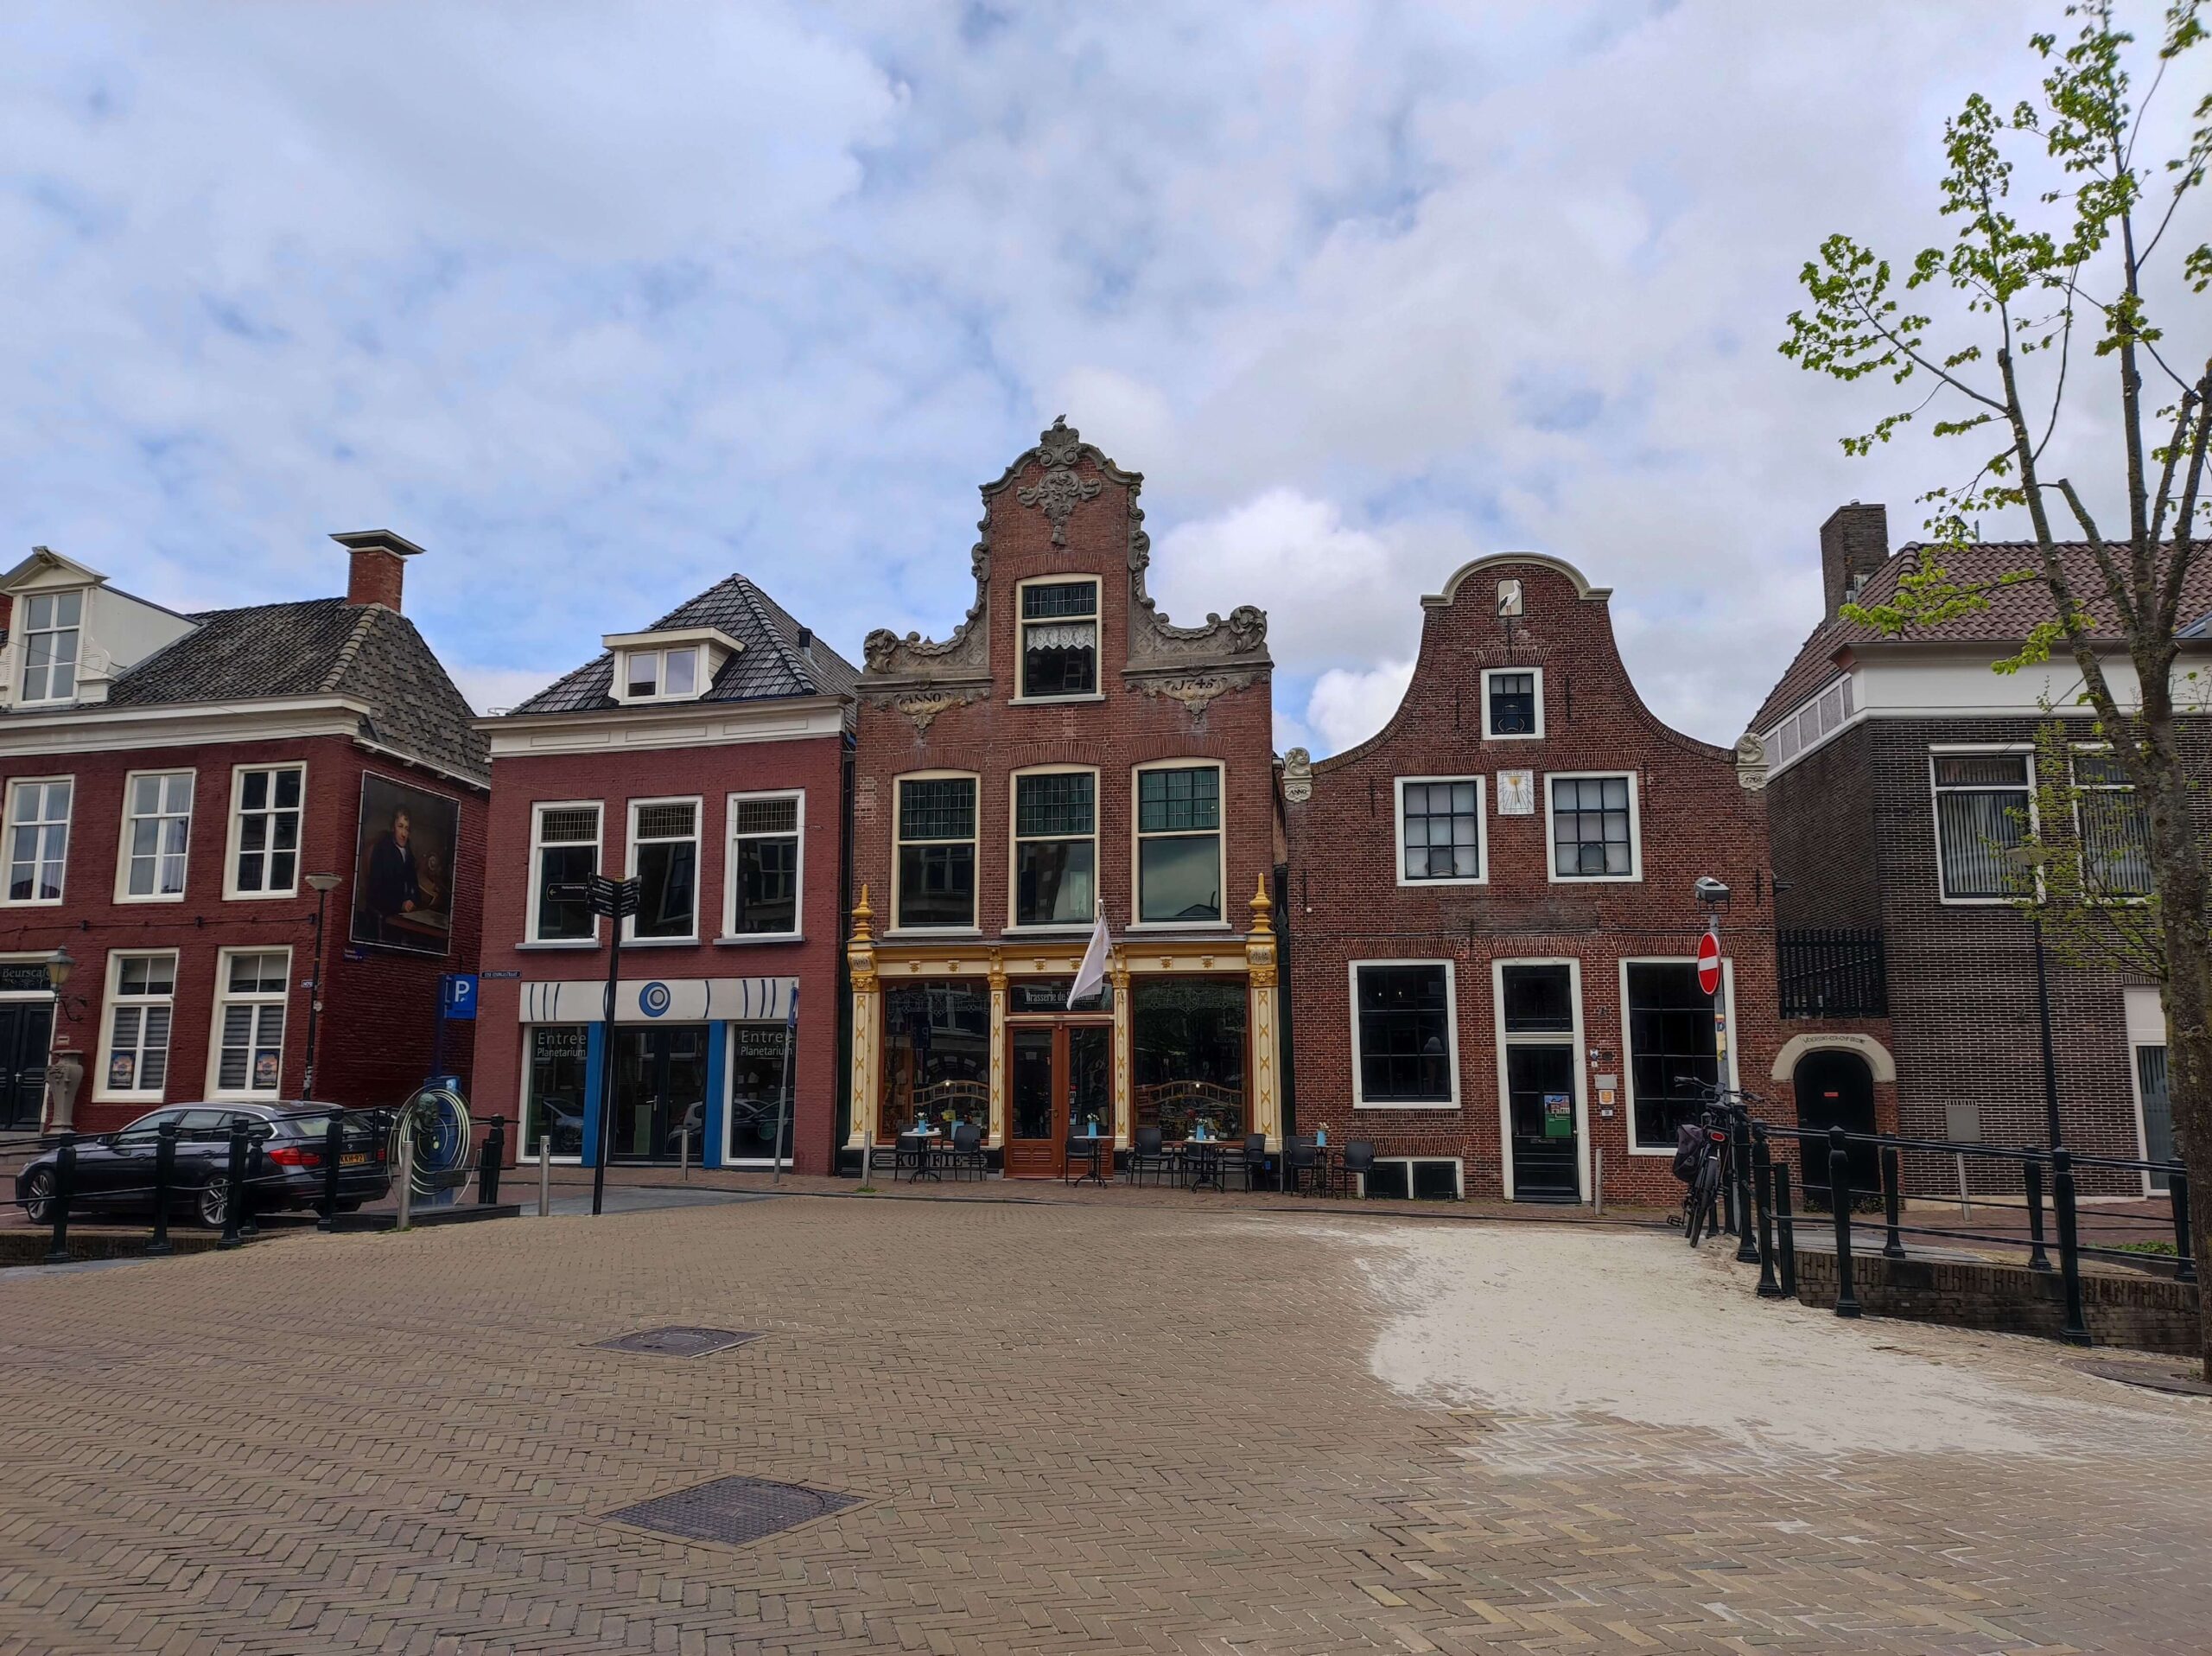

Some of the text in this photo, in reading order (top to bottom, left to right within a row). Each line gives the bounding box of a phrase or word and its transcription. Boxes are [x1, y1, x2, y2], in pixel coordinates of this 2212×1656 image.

[904, 692, 941, 704] ANNO
[454, 980, 470, 1003] P
[1027, 990, 1057, 1003] Brasserie
[1058, 990, 1065, 1002] de
[537, 1032, 587, 1045] Entree
[537, 1047, 586, 1057] Planetarium
[897, 1154, 963, 1167] KOFIE
